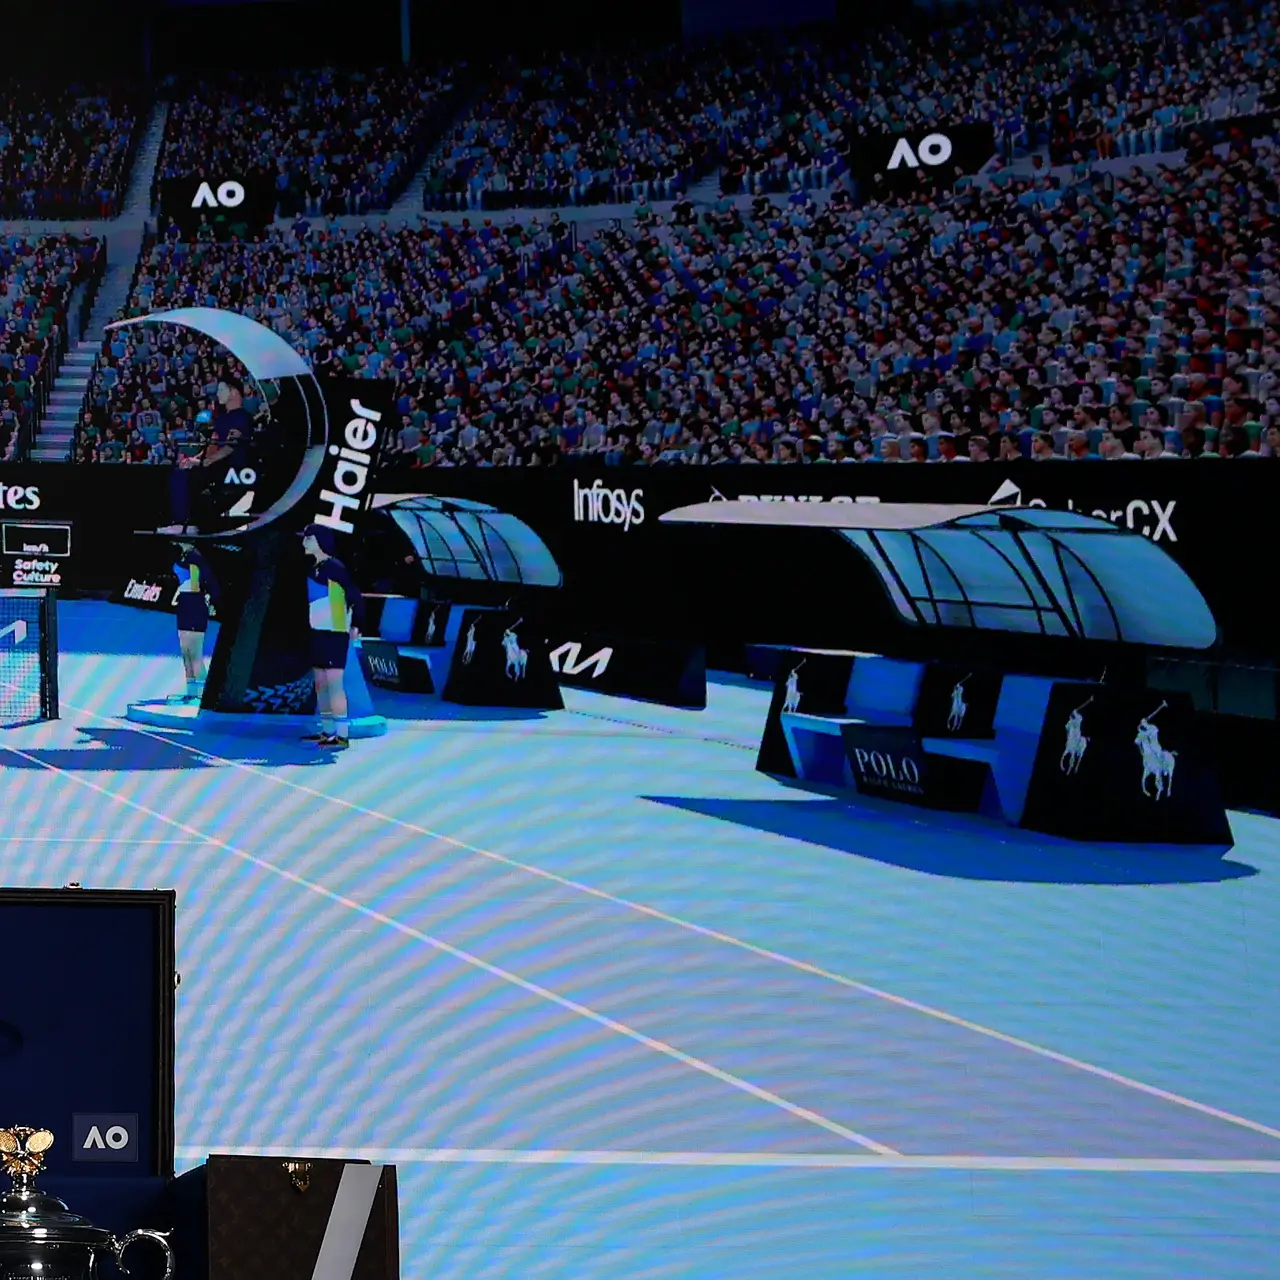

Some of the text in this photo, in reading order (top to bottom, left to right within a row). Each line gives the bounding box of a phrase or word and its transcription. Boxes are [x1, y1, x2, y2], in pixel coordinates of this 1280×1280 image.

[886, 133, 952, 169] AO
[191, 181, 245, 207] AO
[223, 466, 257, 486] AO
[313, 397, 383, 535] Haier
[573, 479, 645, 531] Infosys
[13, 572, 62, 584] Culture
[14, 559, 59, 574] Safety
[853, 747, 920, 785] POLO
[82, 1125, 129, 1150] AO
